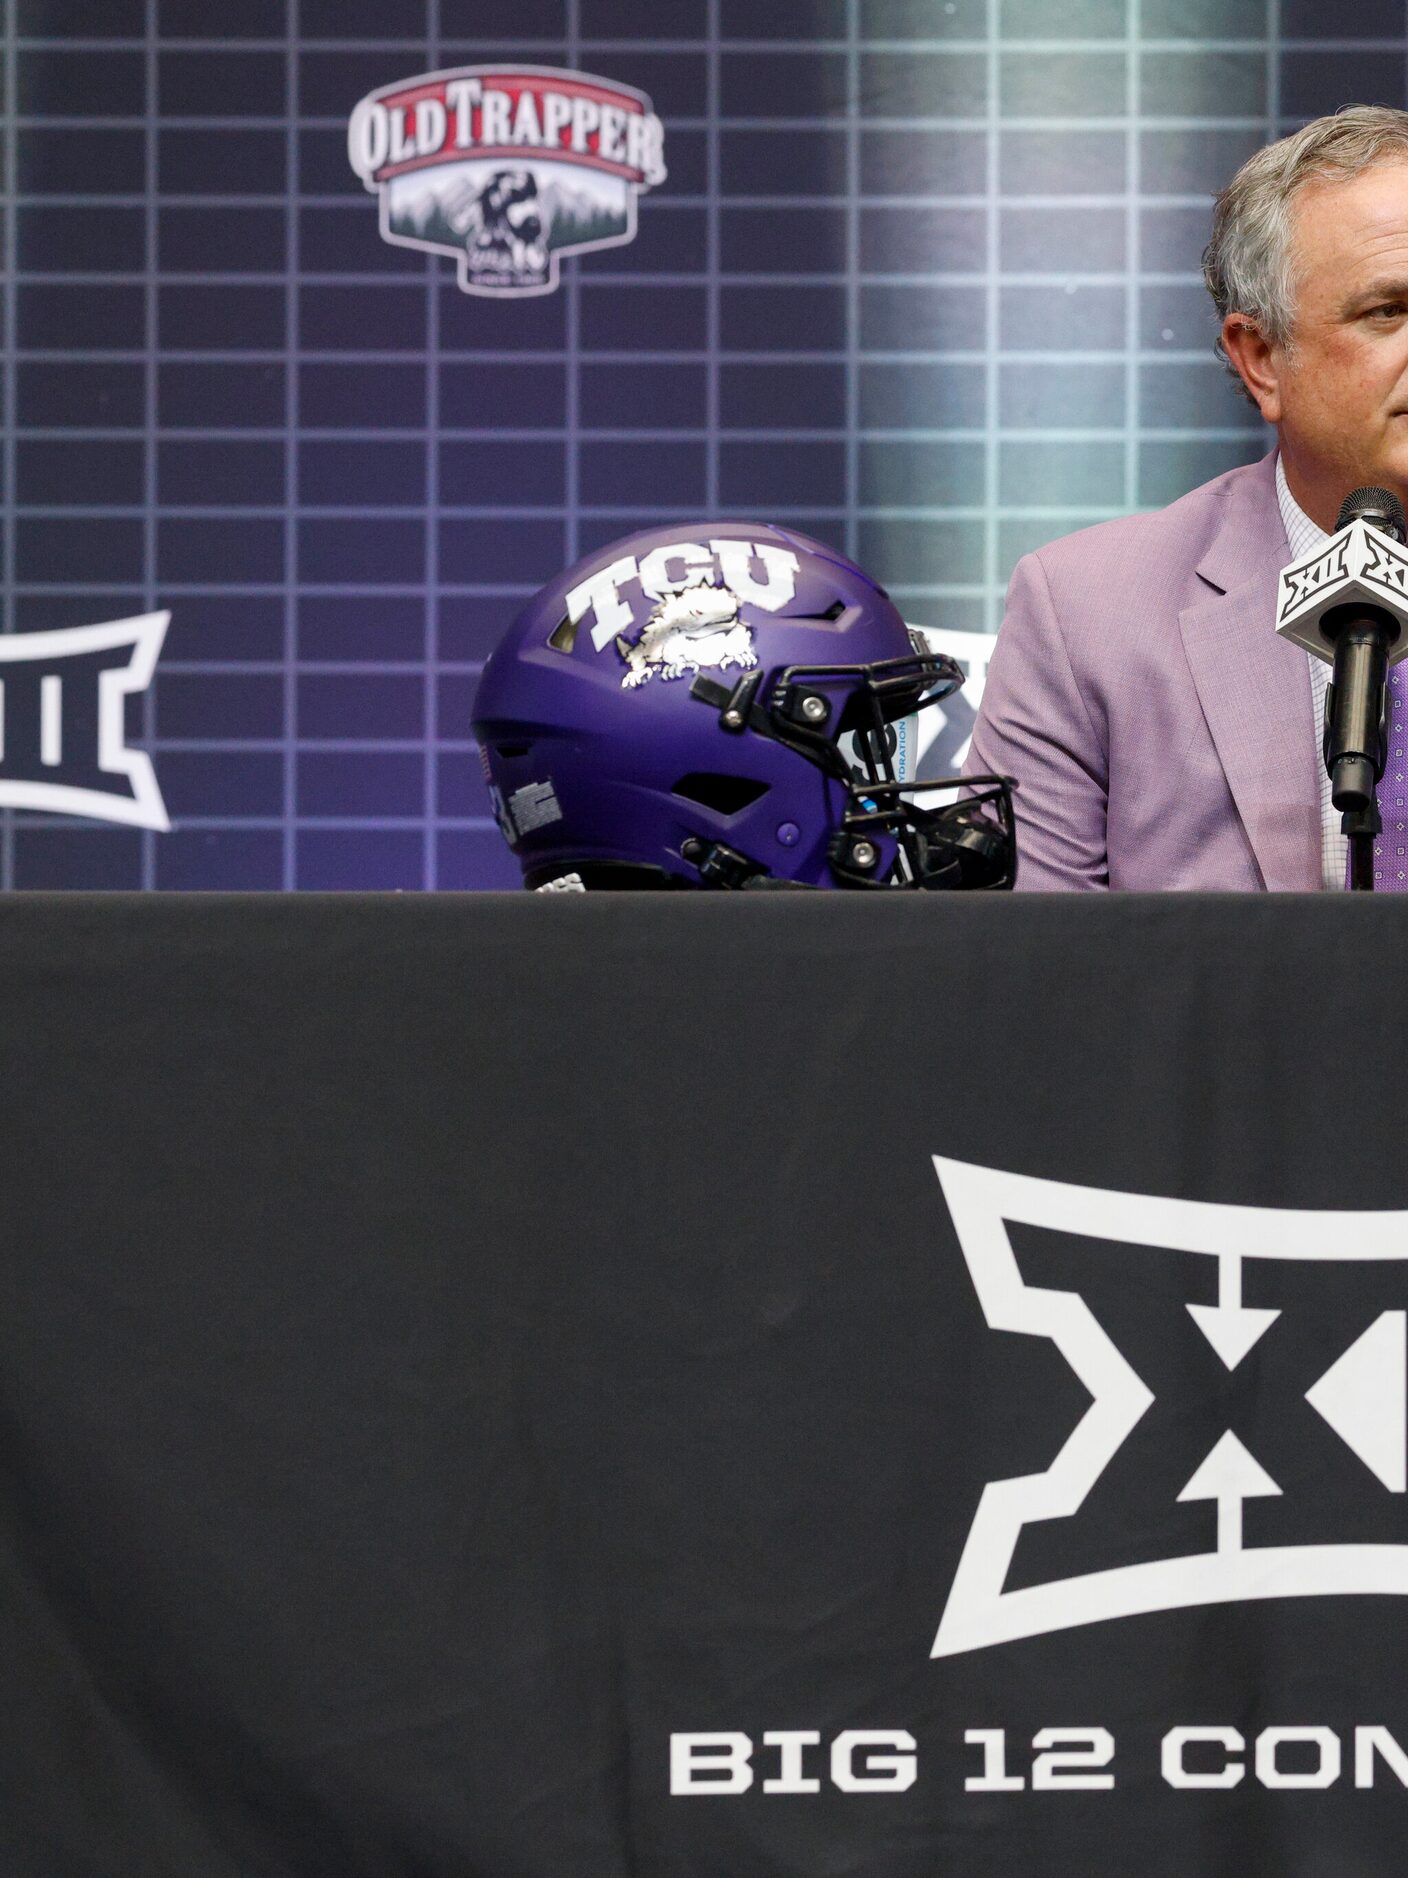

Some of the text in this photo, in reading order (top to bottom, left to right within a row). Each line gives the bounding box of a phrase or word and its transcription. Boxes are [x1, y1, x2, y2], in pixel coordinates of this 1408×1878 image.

[348, 78, 666, 185] OLD TRAPPER
[566, 539, 800, 652] TCU
[898, 720, 906, 784] YDRATION
[670, 1730, 916, 1795] BIG
[965, 1728, 1114, 1791] 12
